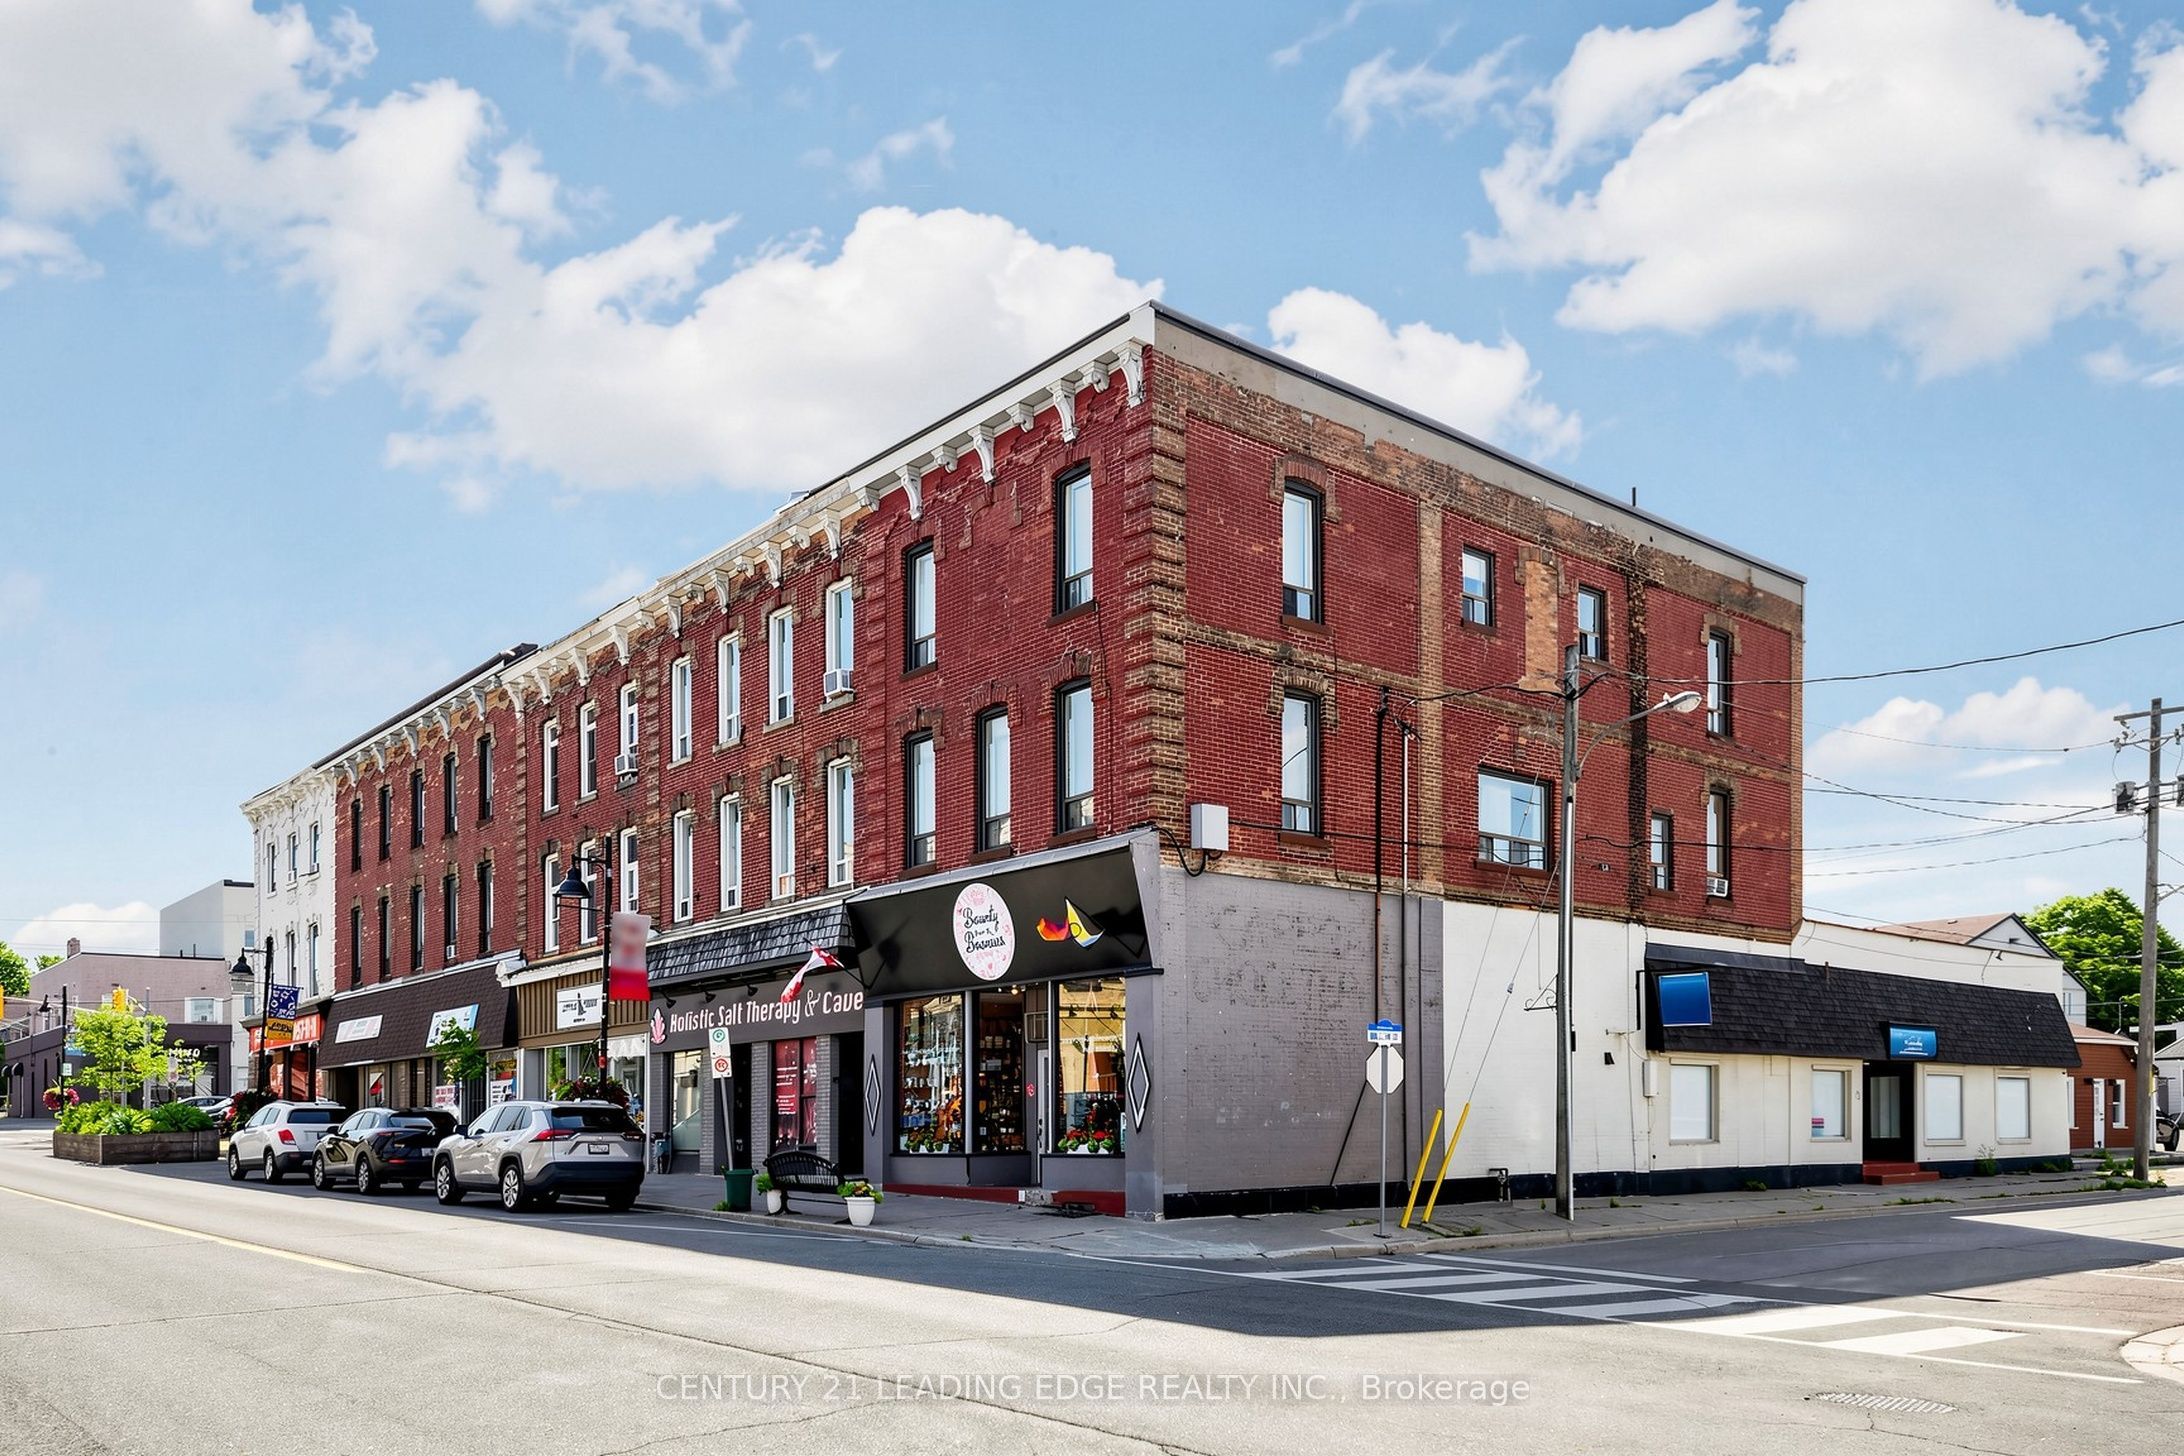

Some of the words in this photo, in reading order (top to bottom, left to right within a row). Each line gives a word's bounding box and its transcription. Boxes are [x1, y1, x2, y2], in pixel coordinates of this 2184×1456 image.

[669, 1008, 715, 1033] Holistic
[717, 1002, 743, 1027] Salt
[746, 999, 801, 1024] Therapy
[805, 989, 821, 1017] &
[822, 991, 864, 1014] Cave
